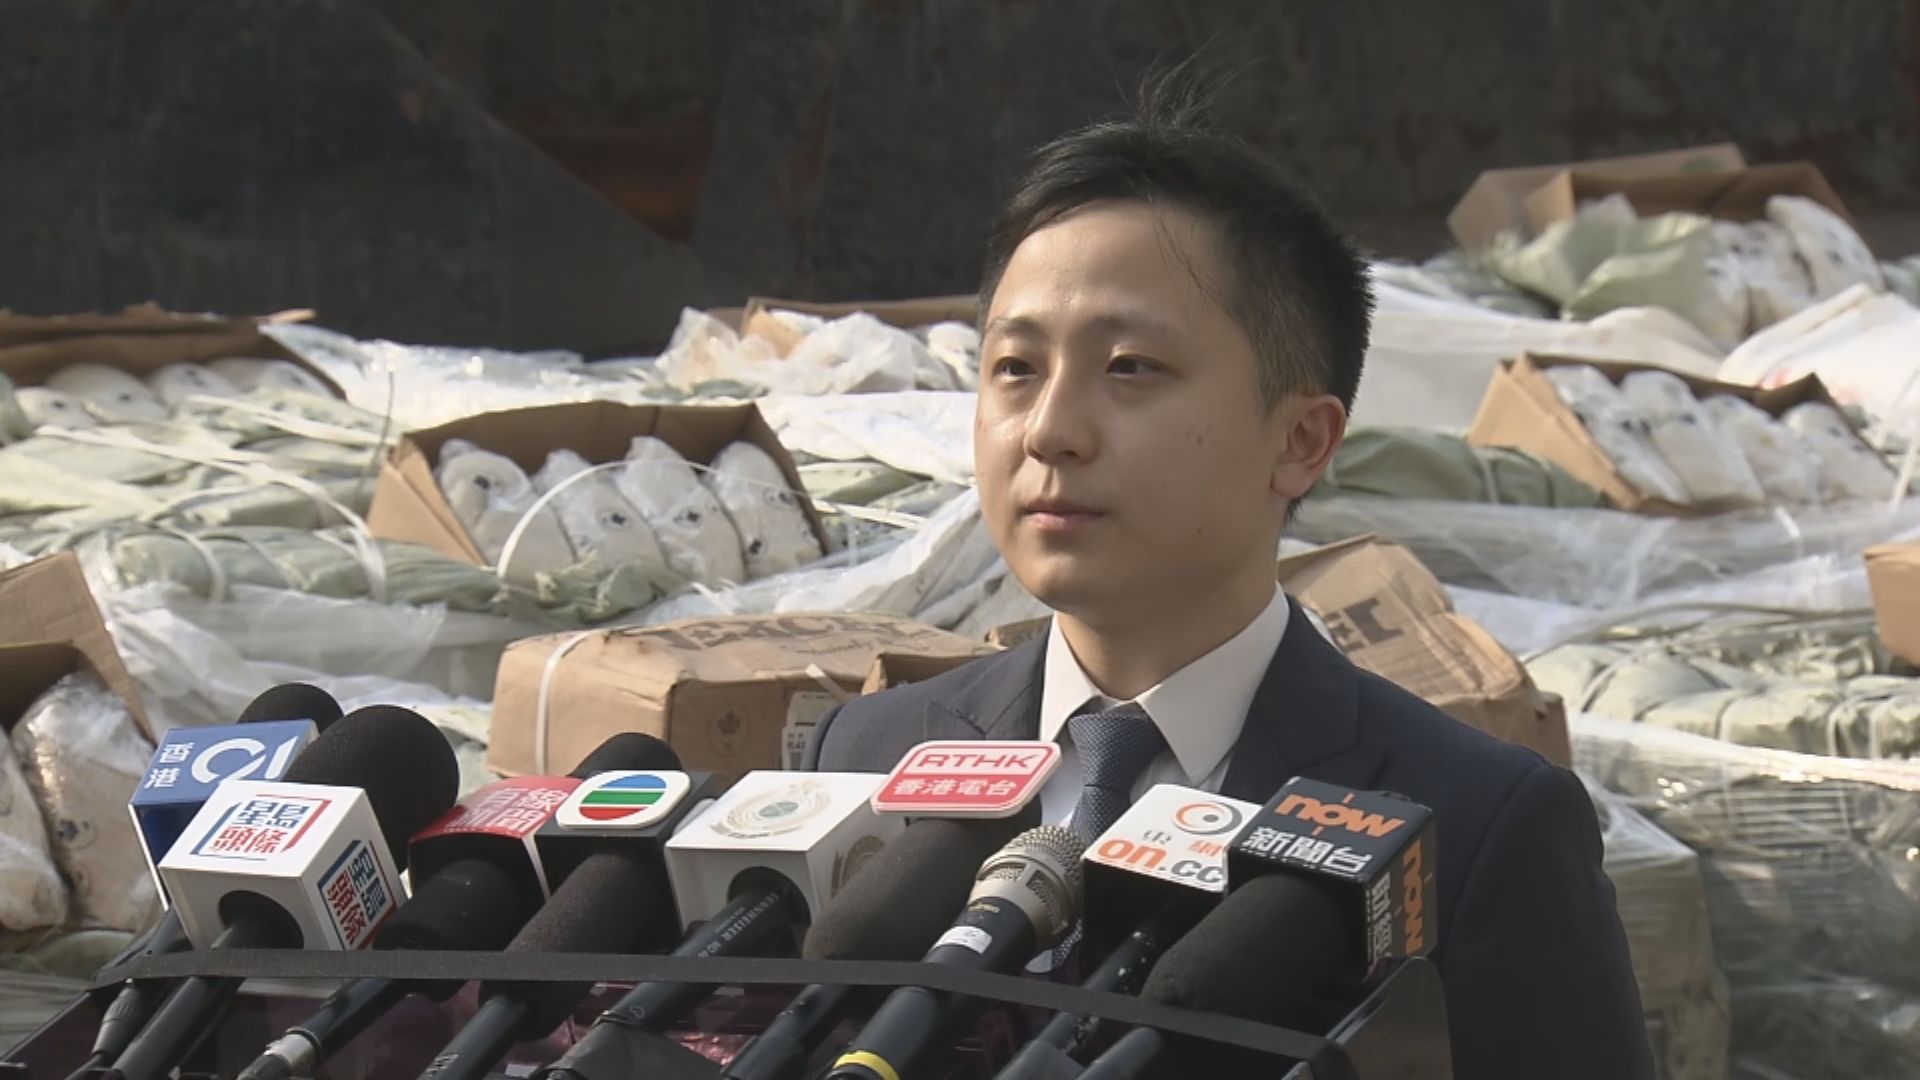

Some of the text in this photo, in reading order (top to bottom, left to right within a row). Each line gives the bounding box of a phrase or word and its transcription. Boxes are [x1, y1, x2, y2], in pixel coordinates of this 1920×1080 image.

[144, 742, 194, 789] 香港
[918, 754, 1038, 768] RTHK
[893, 778, 1017, 796] 香港電台
[232, 800, 312, 828] 星島
[1274, 793, 1406, 838] now
[208, 825, 288, 854] 頭條
[1097, 838, 1224, 883] on.cc
[1242, 826, 1373, 873] 新聞台
[347, 846, 387, 922] 星島
[1403, 838, 1424, 956] now
